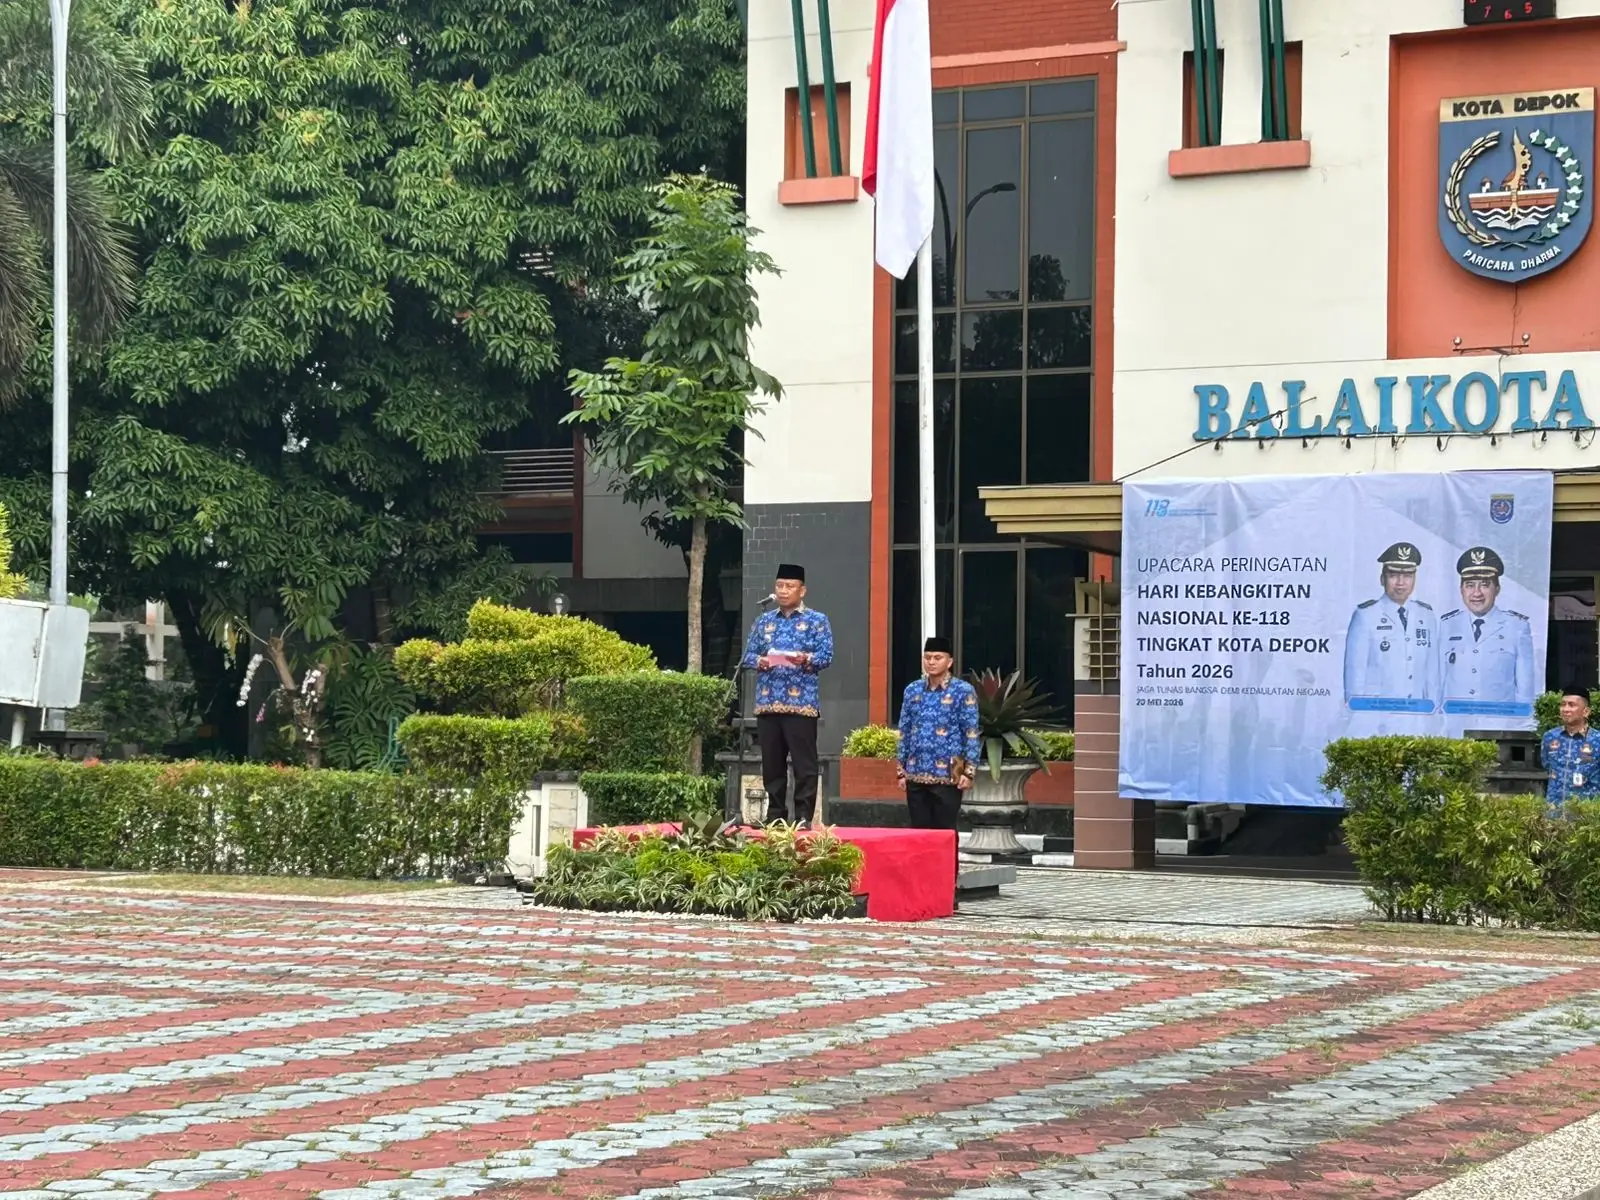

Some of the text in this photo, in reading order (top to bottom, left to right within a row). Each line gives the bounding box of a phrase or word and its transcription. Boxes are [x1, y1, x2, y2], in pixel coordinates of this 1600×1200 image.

[1484, 5, 1491, 19] 7
[1504, 9, 1513, 20] 6
[1524, 2, 1532, 14] 5
[1452, 92, 1580, 118] KOTA DEPOK
[1462, 245, 1561, 271] PARICARA DHARMA
[1193, 369, 1594, 442] BALAIKOTA
[1144, 499, 1170, 518] 118
[1137, 557, 1328, 573] UPACARA PERINGATAN
[1137, 584, 1312, 599] HARI KEBANGKITAN
[1137, 611, 1291, 626] NASIONAL KE-118
[1137, 637, 1330, 653] TINGKAT KOTA DEPOK
[1136, 664, 1234, 679] Tahun 2026
[1136, 685, 1155, 694] JAGA
[1157, 685, 1184, 694] TUNAS
[1185, 686, 1218, 695] BANGSA
[1296, 687, 1331, 697] NEGARA
[1136, 698, 1184, 707] 20 MEI 2026
